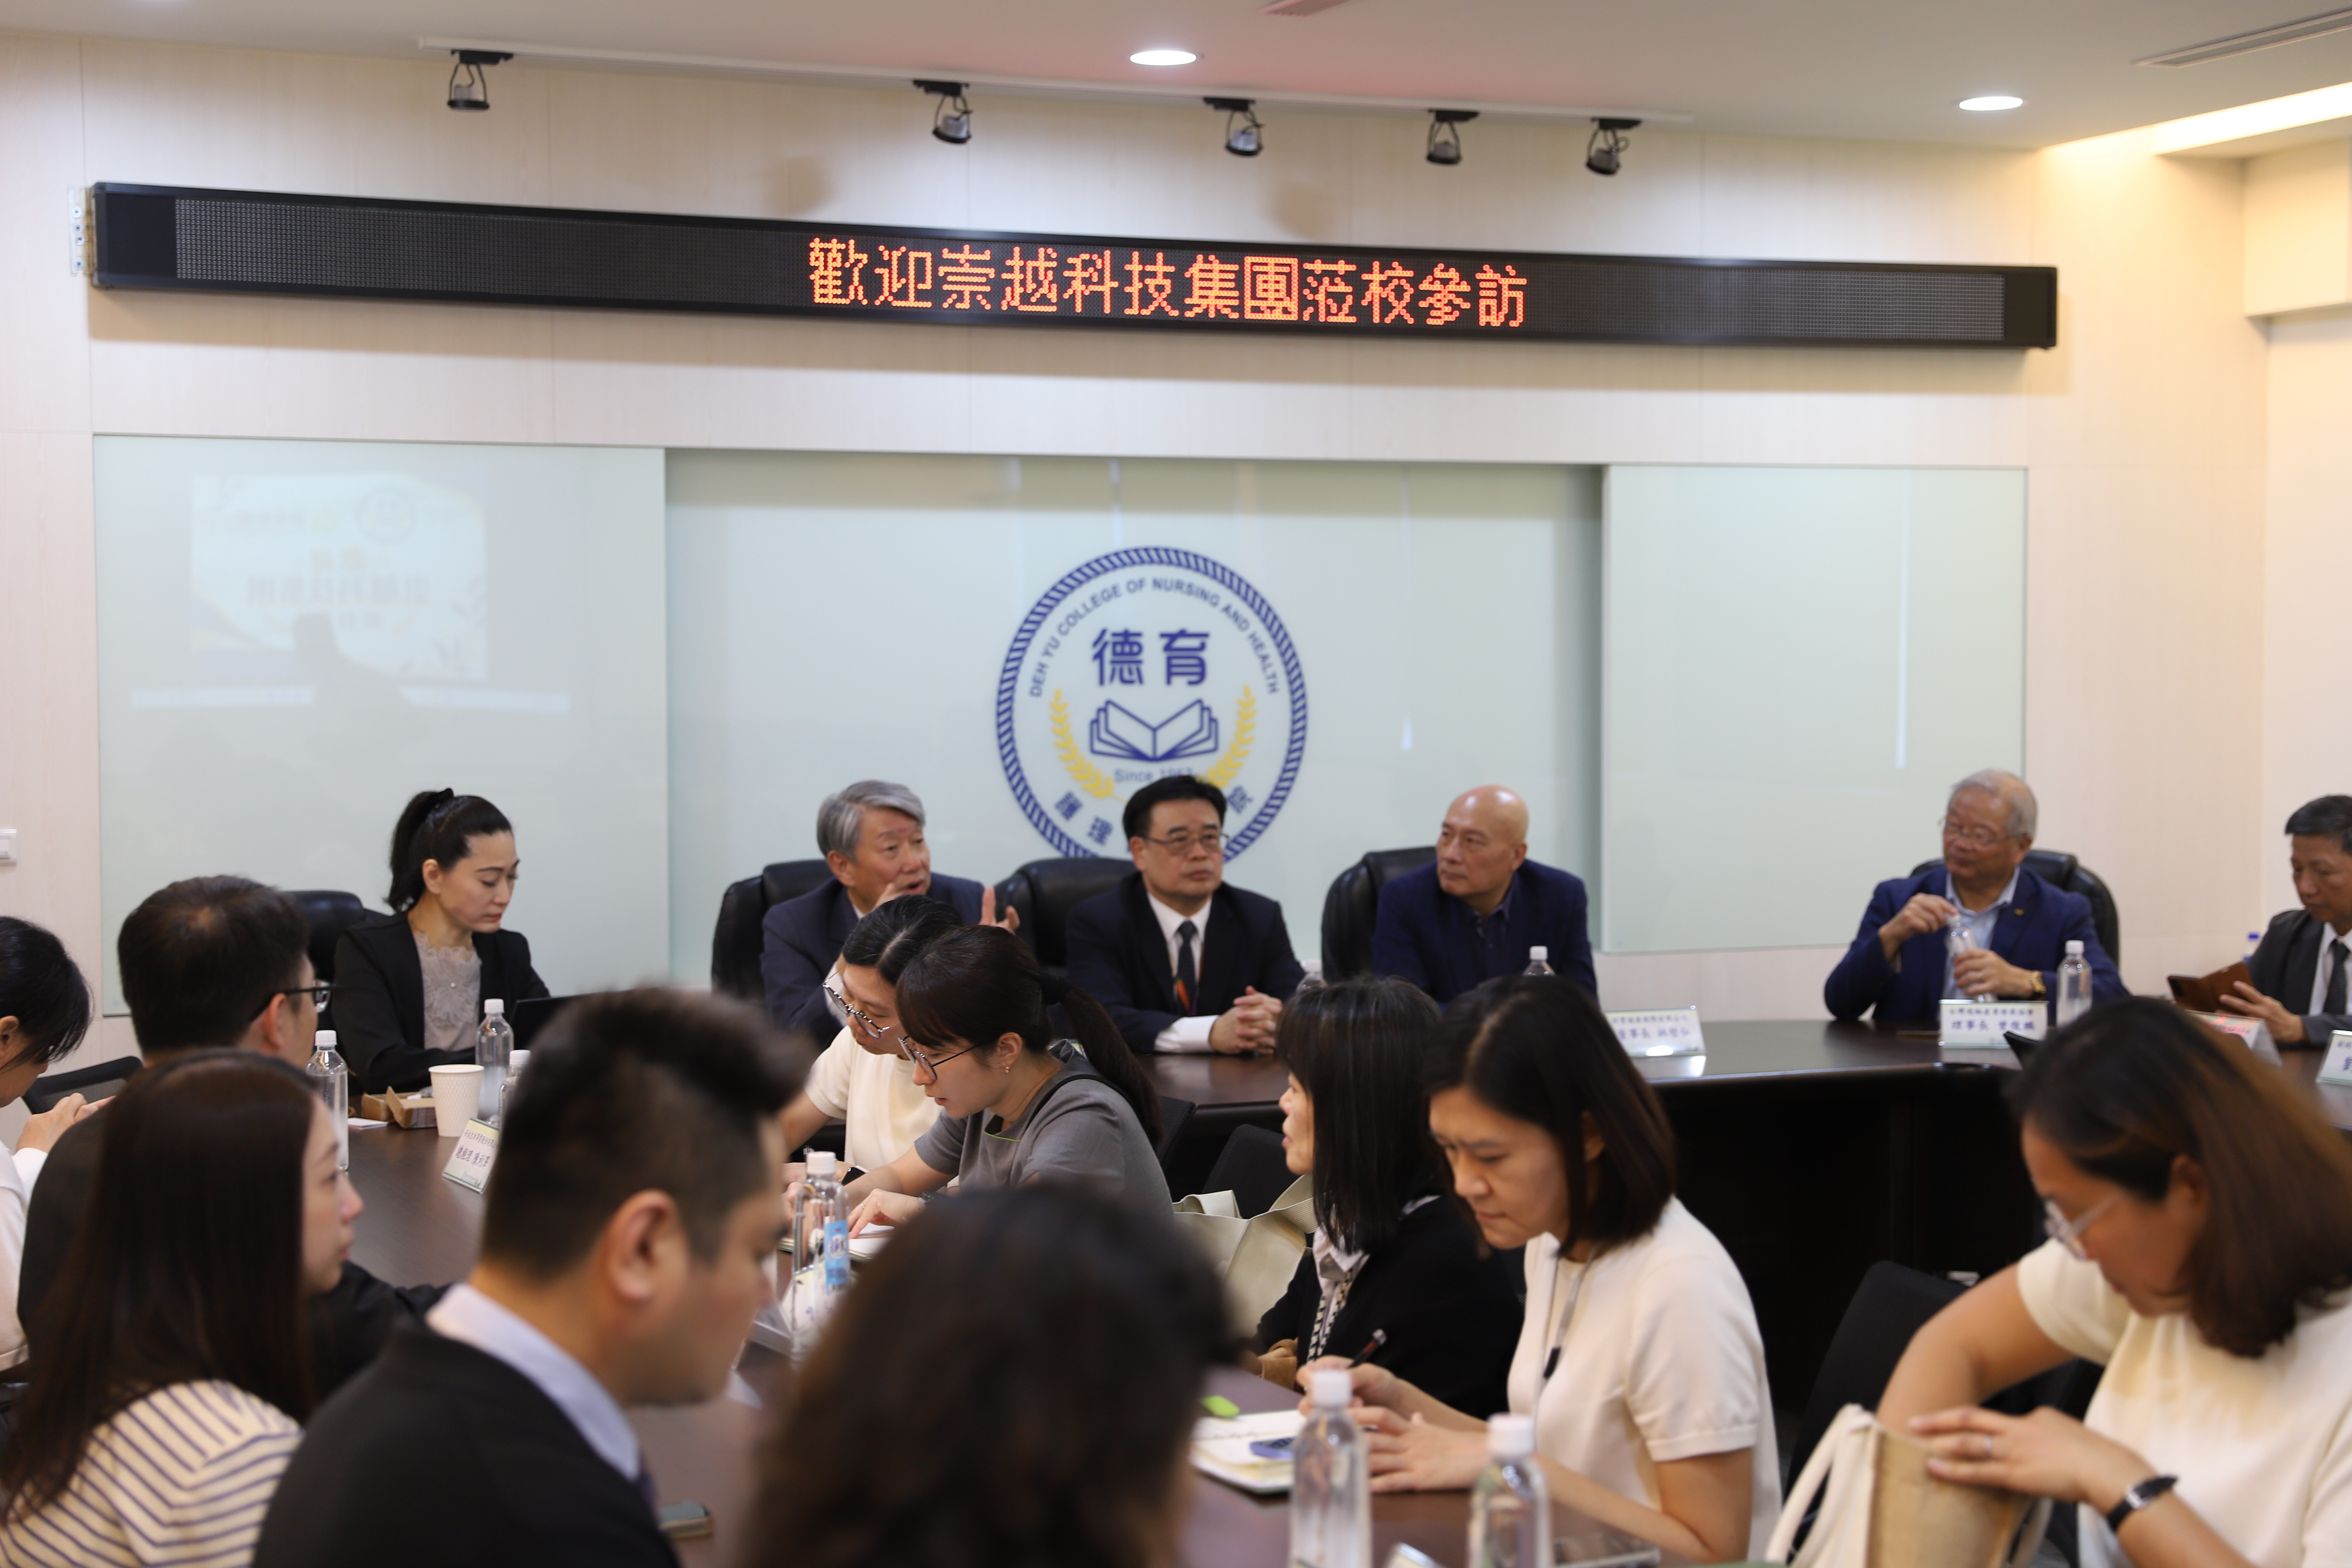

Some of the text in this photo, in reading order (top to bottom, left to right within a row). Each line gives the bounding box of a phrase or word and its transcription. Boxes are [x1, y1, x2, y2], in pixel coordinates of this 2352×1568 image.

[808, 238, 1527, 327] 歡迎崇越科技集團蒞校參訪
[1030, 577, 1279, 697] DEH YU COLLEGE OF NURSING AND HEALTH
[1092, 628, 1210, 686] 德育
[1114, 767, 1153, 784] Since
